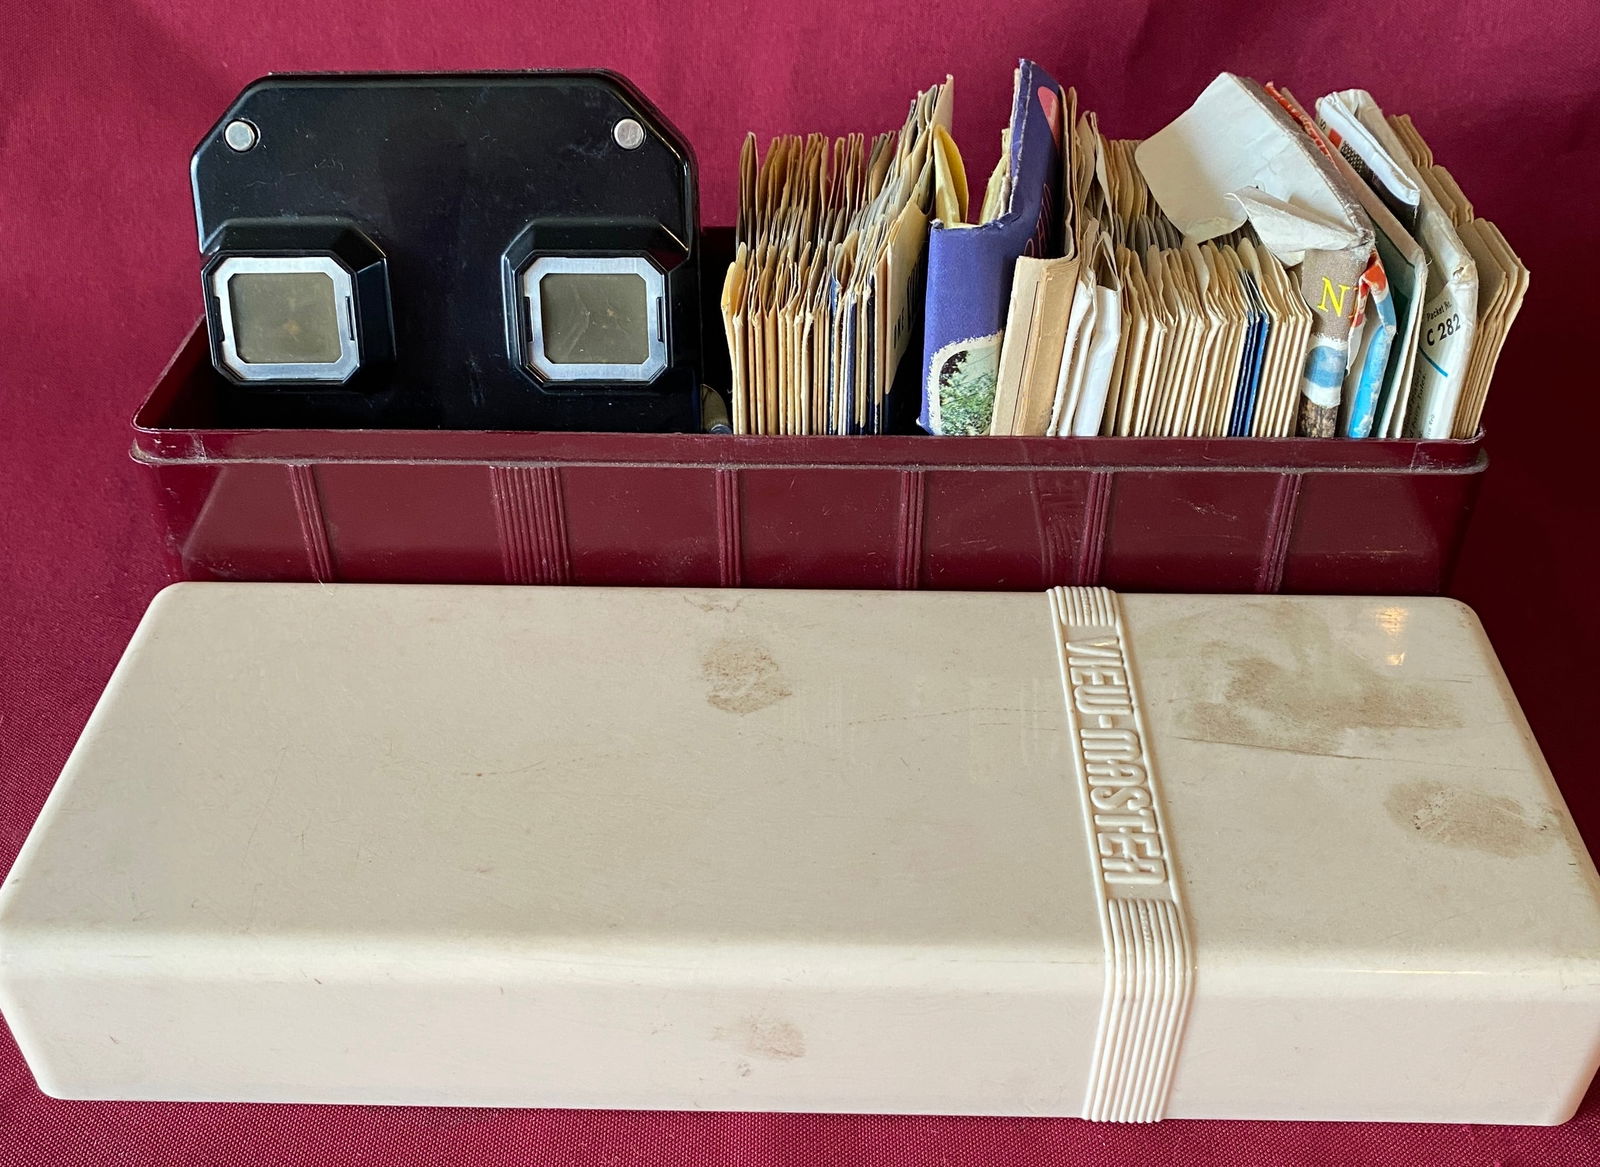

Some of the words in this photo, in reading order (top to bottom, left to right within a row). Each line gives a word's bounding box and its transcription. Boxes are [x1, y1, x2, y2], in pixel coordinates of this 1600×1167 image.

[1317, 276, 1350, 317] N
[1426, 328, 1436, 347] C
[1437, 312, 1461, 341] 282
[1065, 635, 1167, 885] VIEW-MASTER
